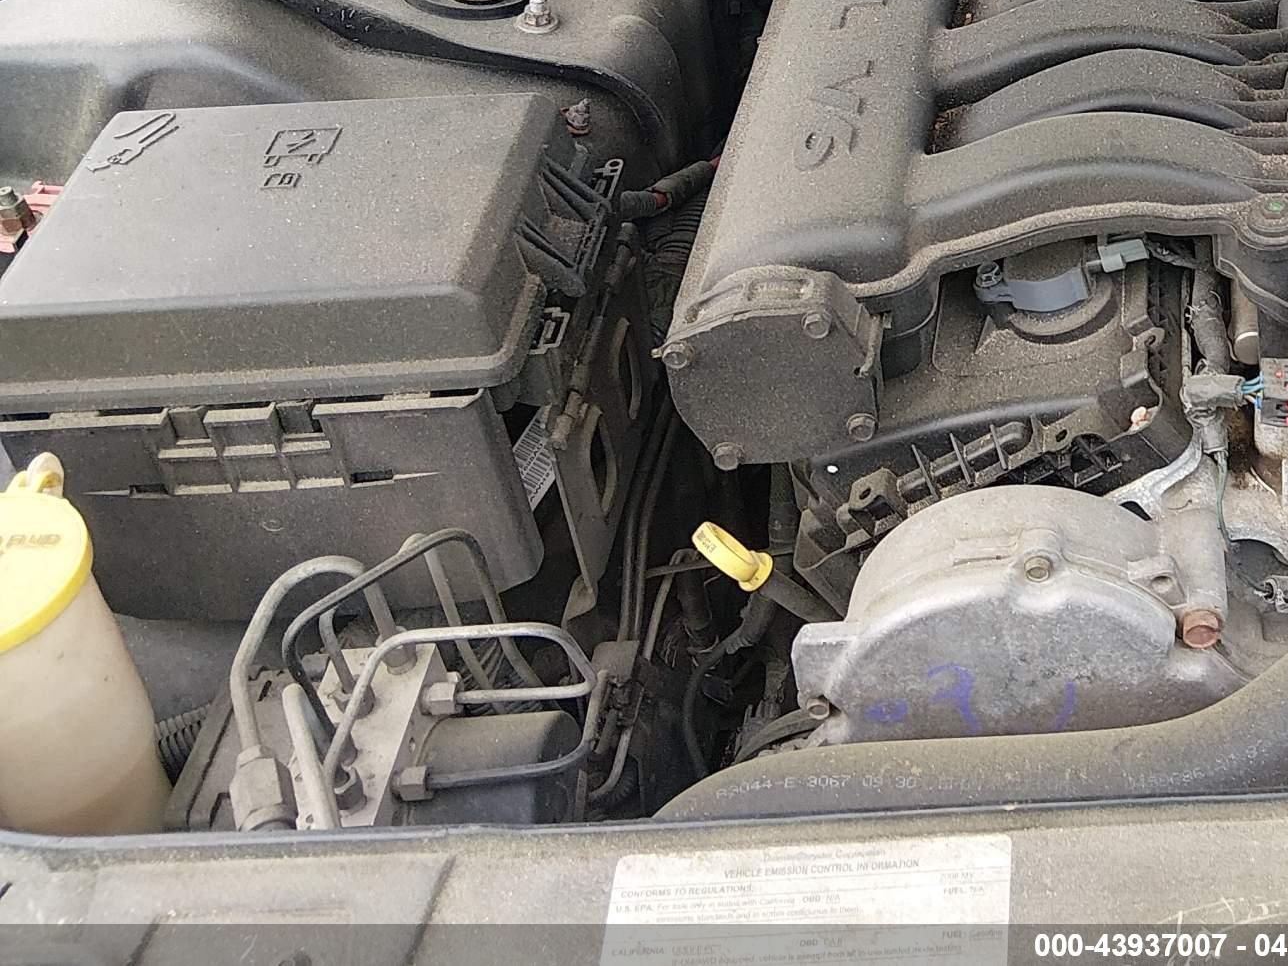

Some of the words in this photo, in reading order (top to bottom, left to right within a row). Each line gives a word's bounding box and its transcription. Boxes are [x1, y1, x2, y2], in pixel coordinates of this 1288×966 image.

[794, 60, 874, 172] V6
[723, 866, 762, 880] VEHICLE
[764, 864, 809, 877] EMISSION
[810, 862, 855, 875] CONTROL
[620, 886, 671, 899] CONFORMS
